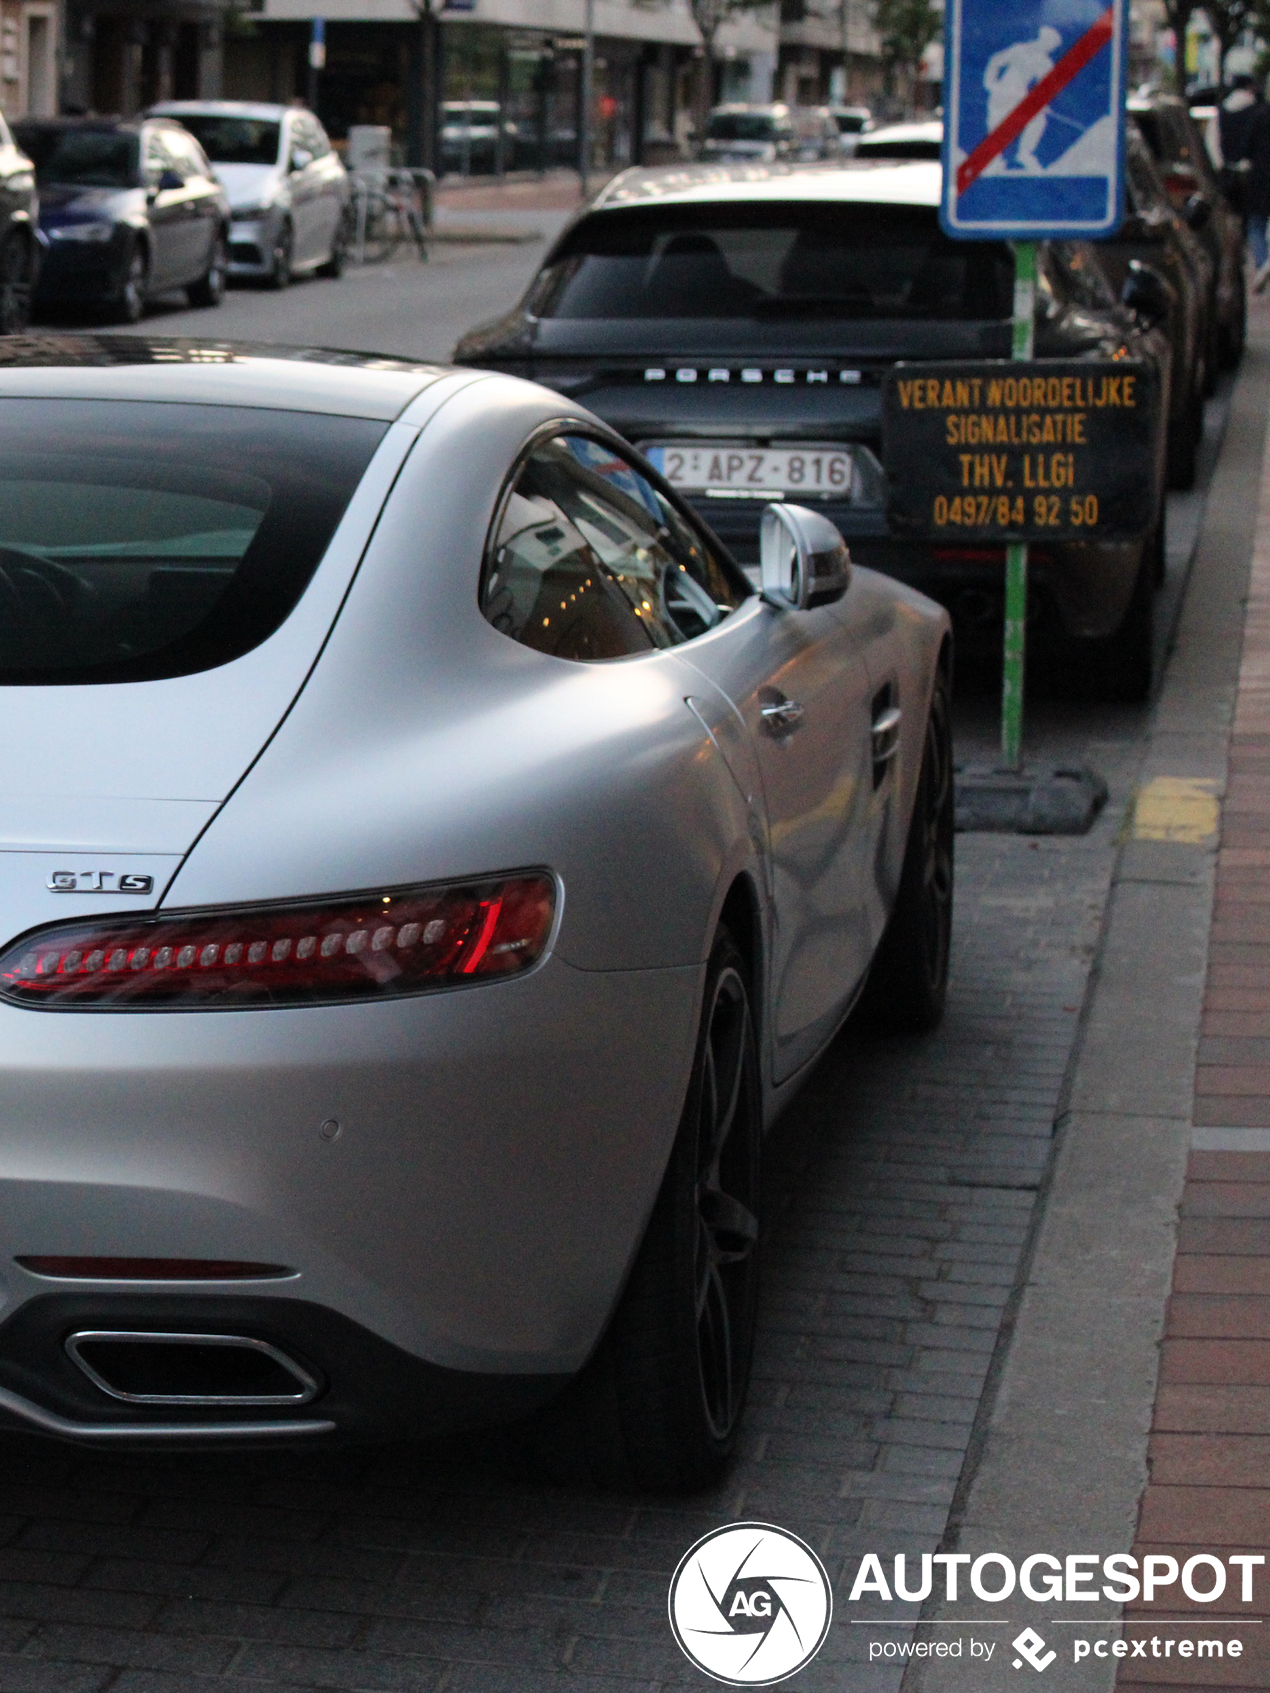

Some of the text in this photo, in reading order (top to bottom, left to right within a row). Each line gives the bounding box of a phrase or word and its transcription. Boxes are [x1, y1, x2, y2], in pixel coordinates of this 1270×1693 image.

[644, 368, 862, 384] PORSCHE
[946, 413, 1086, 445] SIGNALISATIE
[959, 453, 1013, 487] THV.
[934, 494, 1099, 526] 0497/84 92 50
